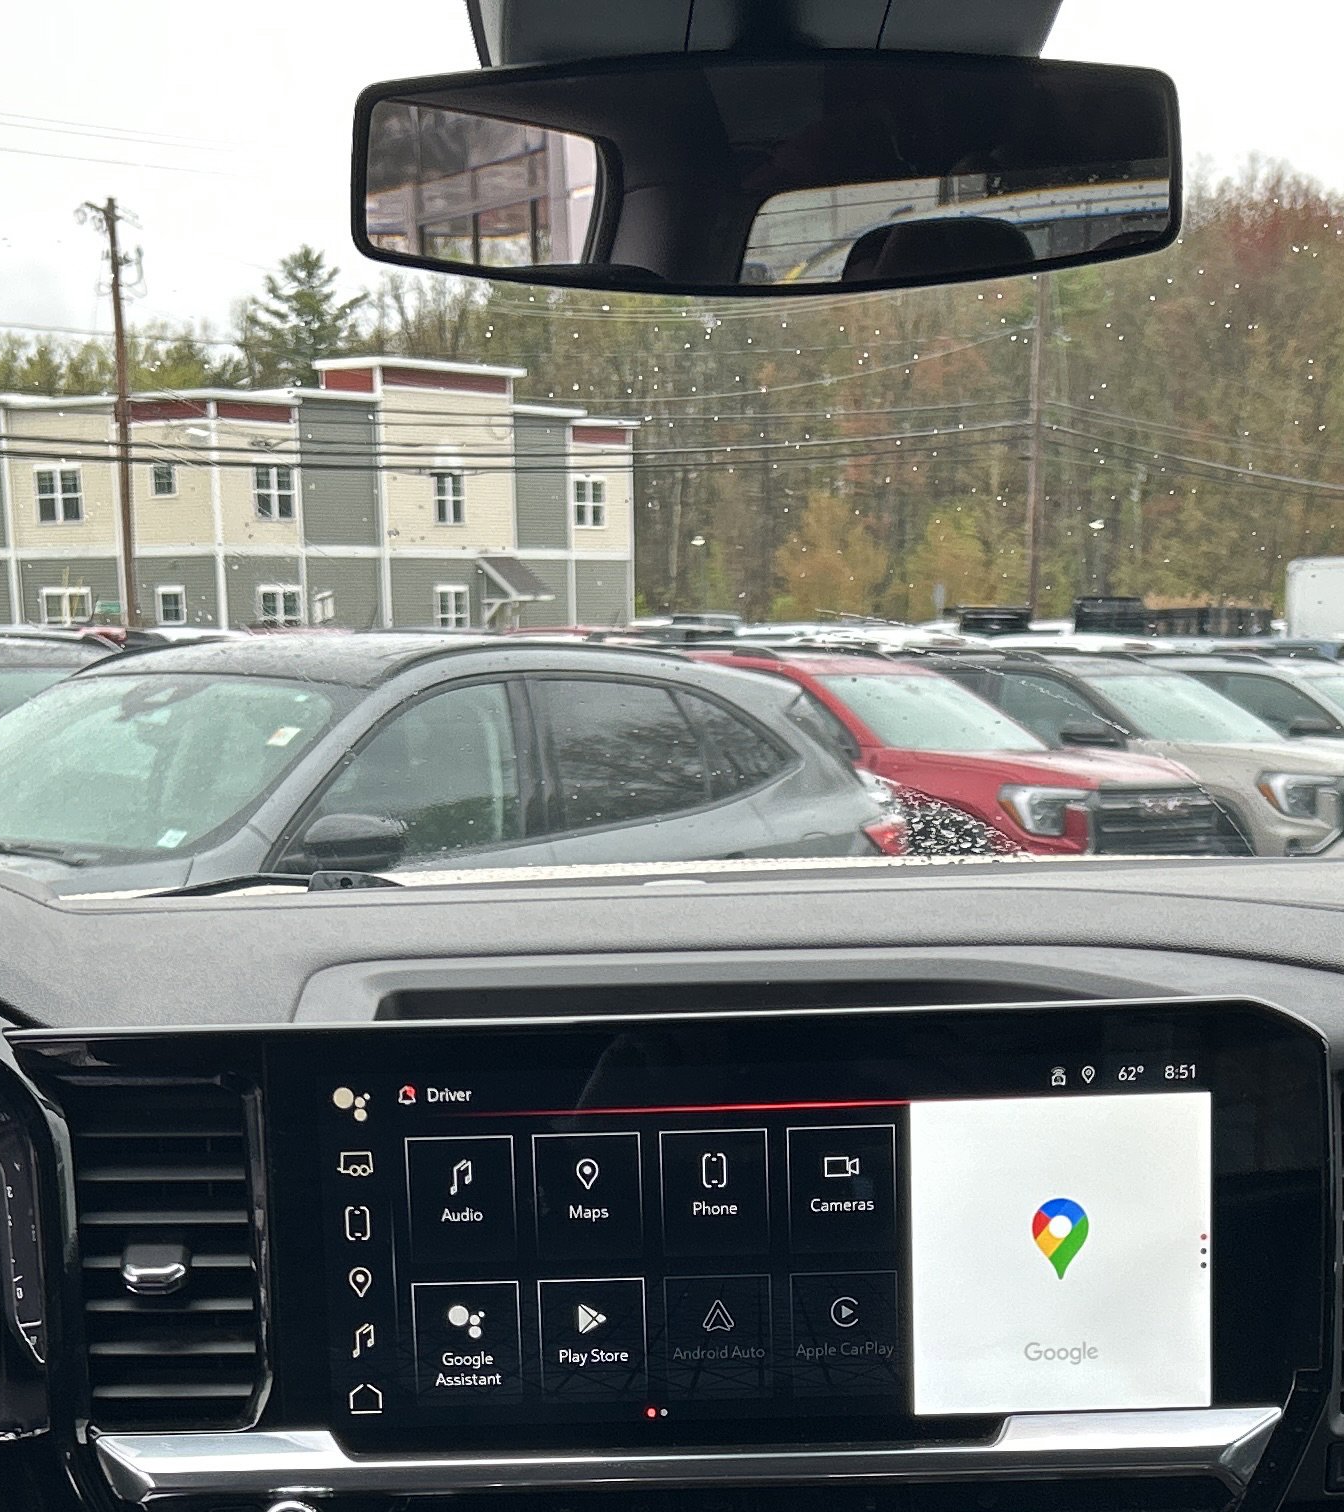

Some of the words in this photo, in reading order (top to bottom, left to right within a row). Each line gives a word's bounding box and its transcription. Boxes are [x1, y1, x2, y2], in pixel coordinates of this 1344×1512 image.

[1164, 1064, 1197, 1080] 8:51
[426, 1087, 472, 1102] Driver
[692, 1200, 739, 1217] Phone
[810, 1196, 875, 1213] Cameras
[441, 1207, 484, 1223] Audio
[568, 1205, 609, 1223] Maps
[558, 1349, 588, 1367] Play
[591, 1348, 629, 1364] Store
[672, 1345, 727, 1361] Android
[731, 1345, 765, 1360] Auto
[795, 1343, 837, 1360] Apple
[840, 1341, 895, 1359] CarPlay
[1023, 1341, 1099, 1365] Google
[442, 1351, 495, 1370] Google
[435, 1370, 502, 1388] Assistant
